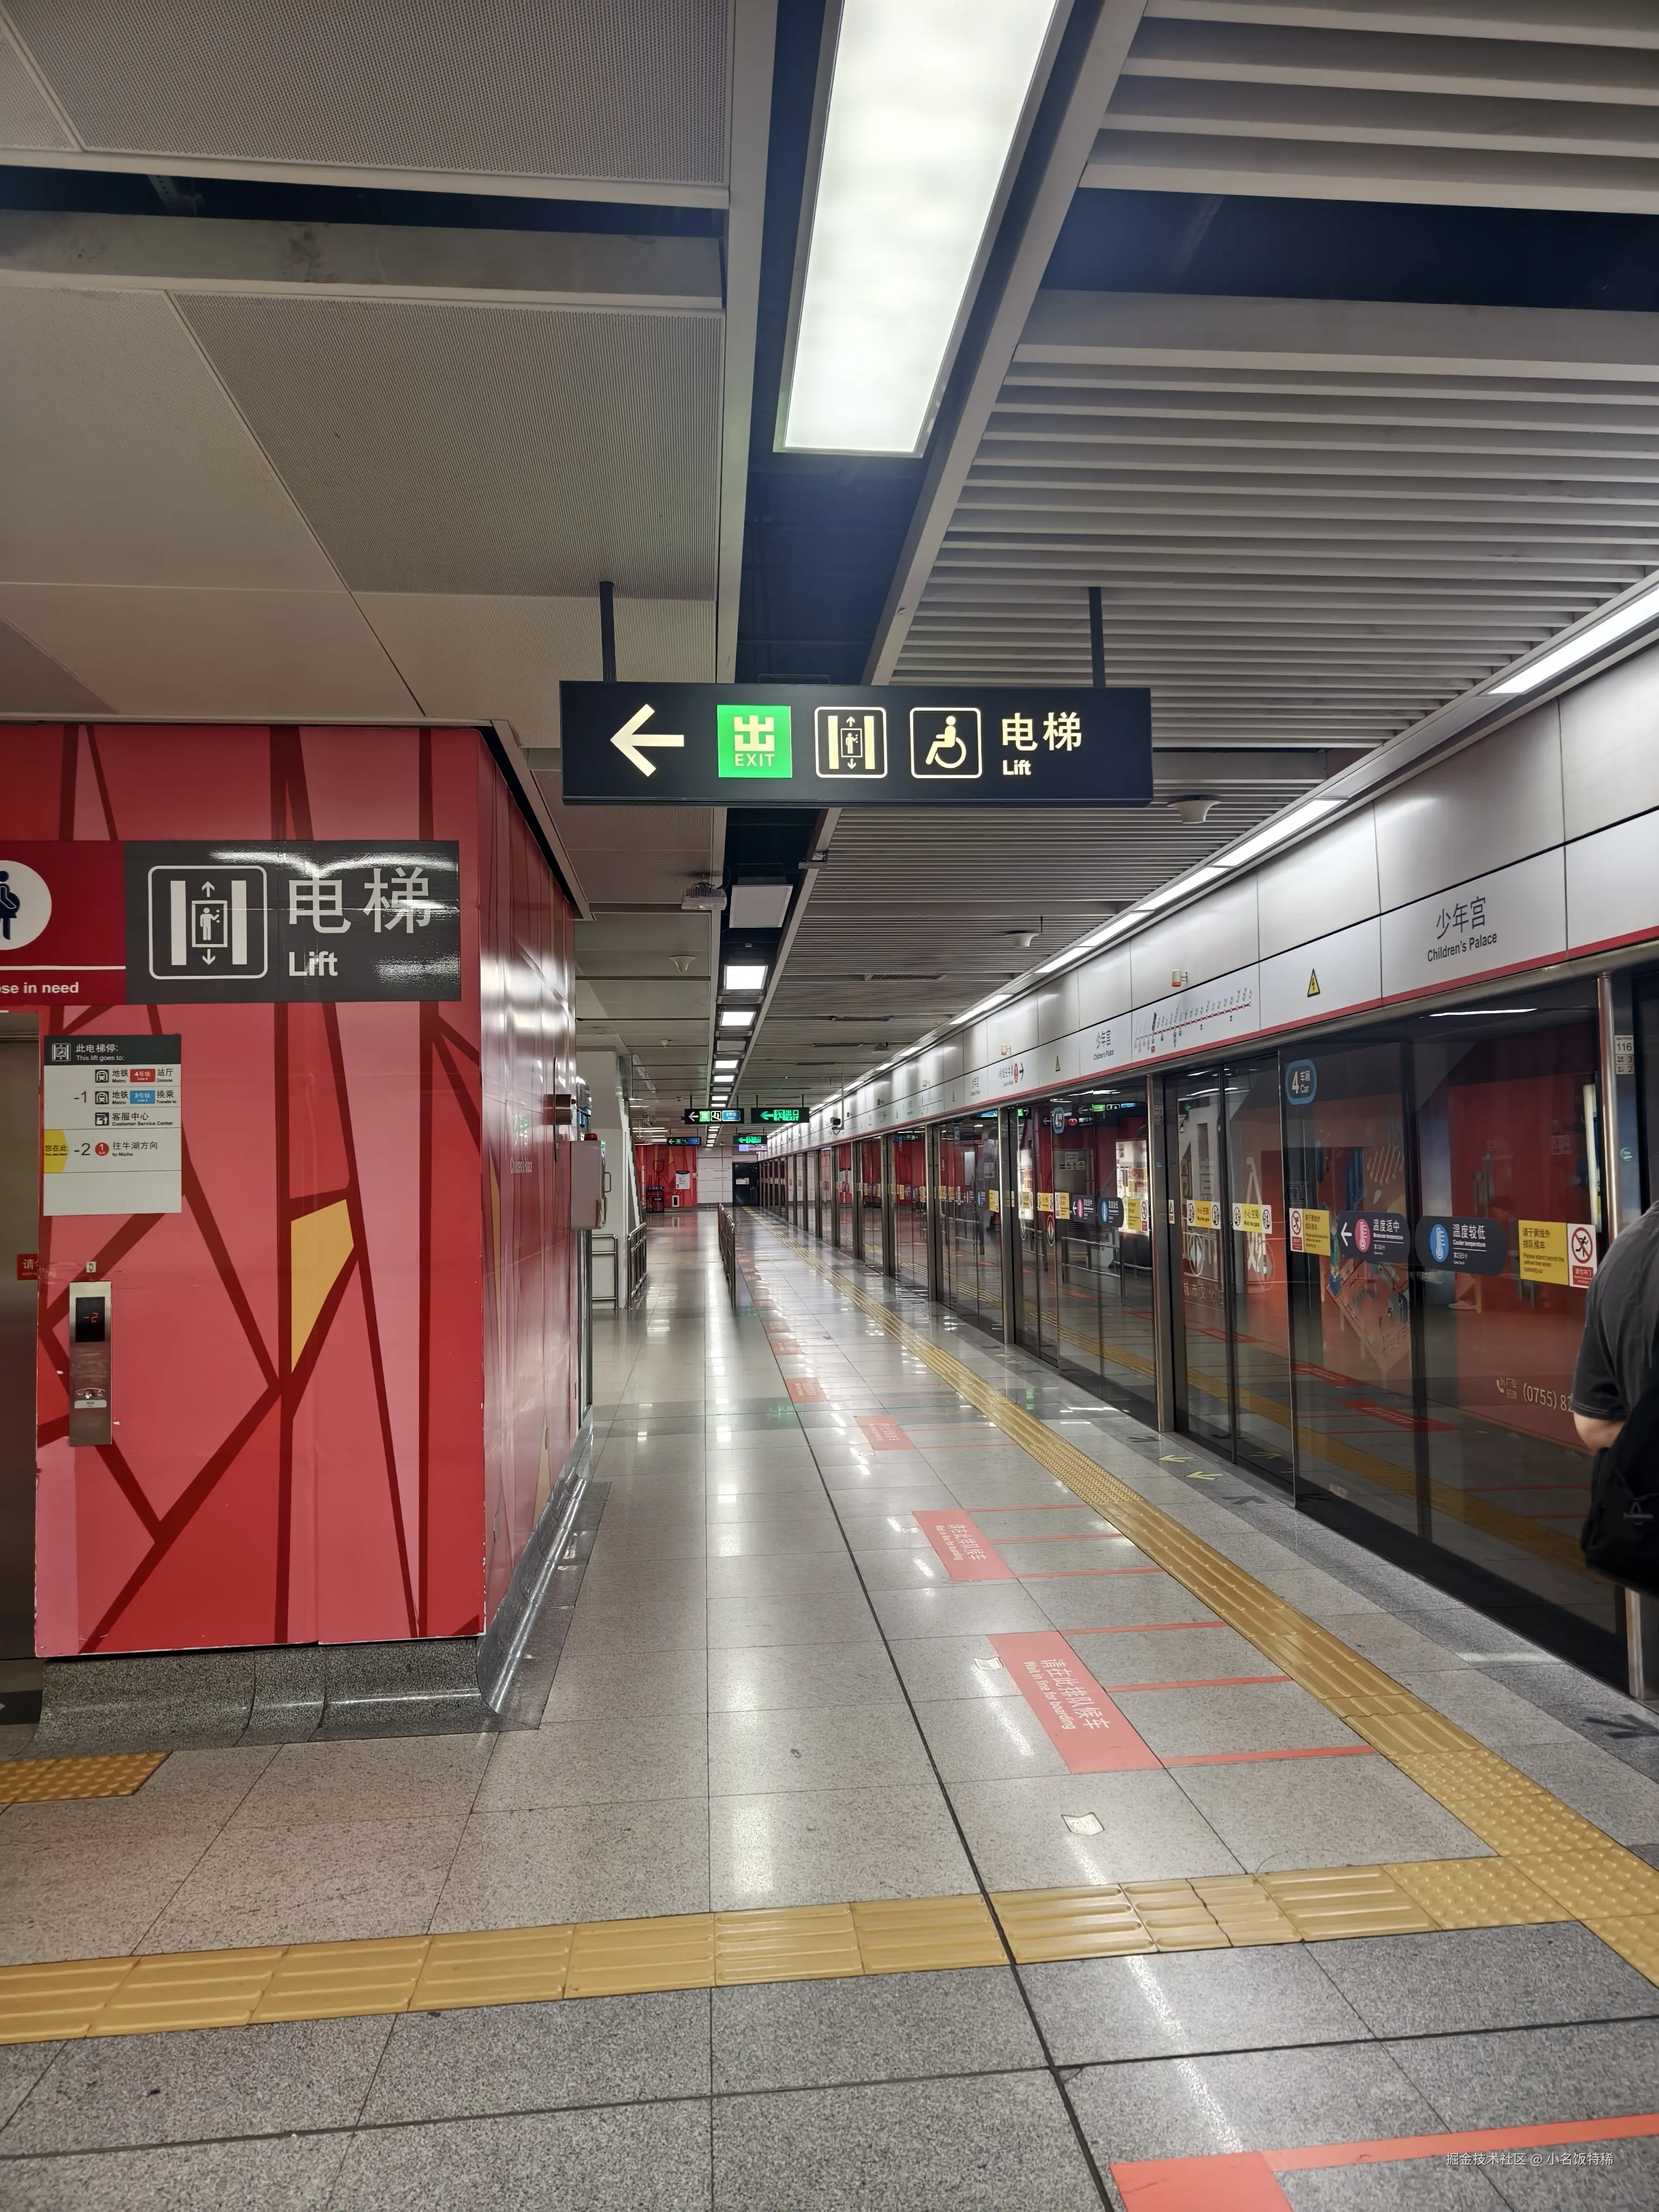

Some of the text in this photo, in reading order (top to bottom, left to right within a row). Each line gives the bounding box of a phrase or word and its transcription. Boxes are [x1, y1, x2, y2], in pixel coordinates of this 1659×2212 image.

[1002, 712, 1082, 751] 电梯
[735, 754, 775, 766] EXIT
[1003, 760, 1031, 775] Lift
[289, 867, 431, 933] 电梯
[1436, 896, 1486, 940] 少年宫
[1427, 933, 1498, 962] Children's Palace
[289, 951, 338, 976] Lift
[0, 982, 79, 994] se in need
[1096, 1029, 1111, 1049] 少年宫
[76, 1043, 119, 1053] 此电梯停:
[1617, 1043, 1632, 1051] 116
[157, 1068, 173, 1076] 站厅
[1292, 1071, 1299, 1094] 4
[1300, 1084, 1309, 1094] Car
[74, 1091, 87, 1103] -1
[157, 1090, 174, 1098] 换乘
[112, 1112, 149, 1121] 客服中心
[74, 1143, 91, 1156] -2
[113, 1142, 158, 1150] 往牛湖方向
[1373, 1219, 1399, 1232] 温度适中
[1453, 1224, 1486, 1239] 温度较低
[1522, 1228, 1550, 1238] 请于黄线外
[1523, 1239, 1546, 1251] 排队候车
[84, 1313, 98, 1323] -2
[1523, 1382, 1557, 1410] (0755)
[947, 1524, 988, 1560] 请在此排队候车
[1023, 1661, 1040, 1674] Wait
[1035, 1680, 1050, 1691] line
[1040, 1658, 1110, 1729] 请在此排队候车
[1043, 1691, 1057, 1701] for
[1049, 1701, 1076, 1729] boarding
